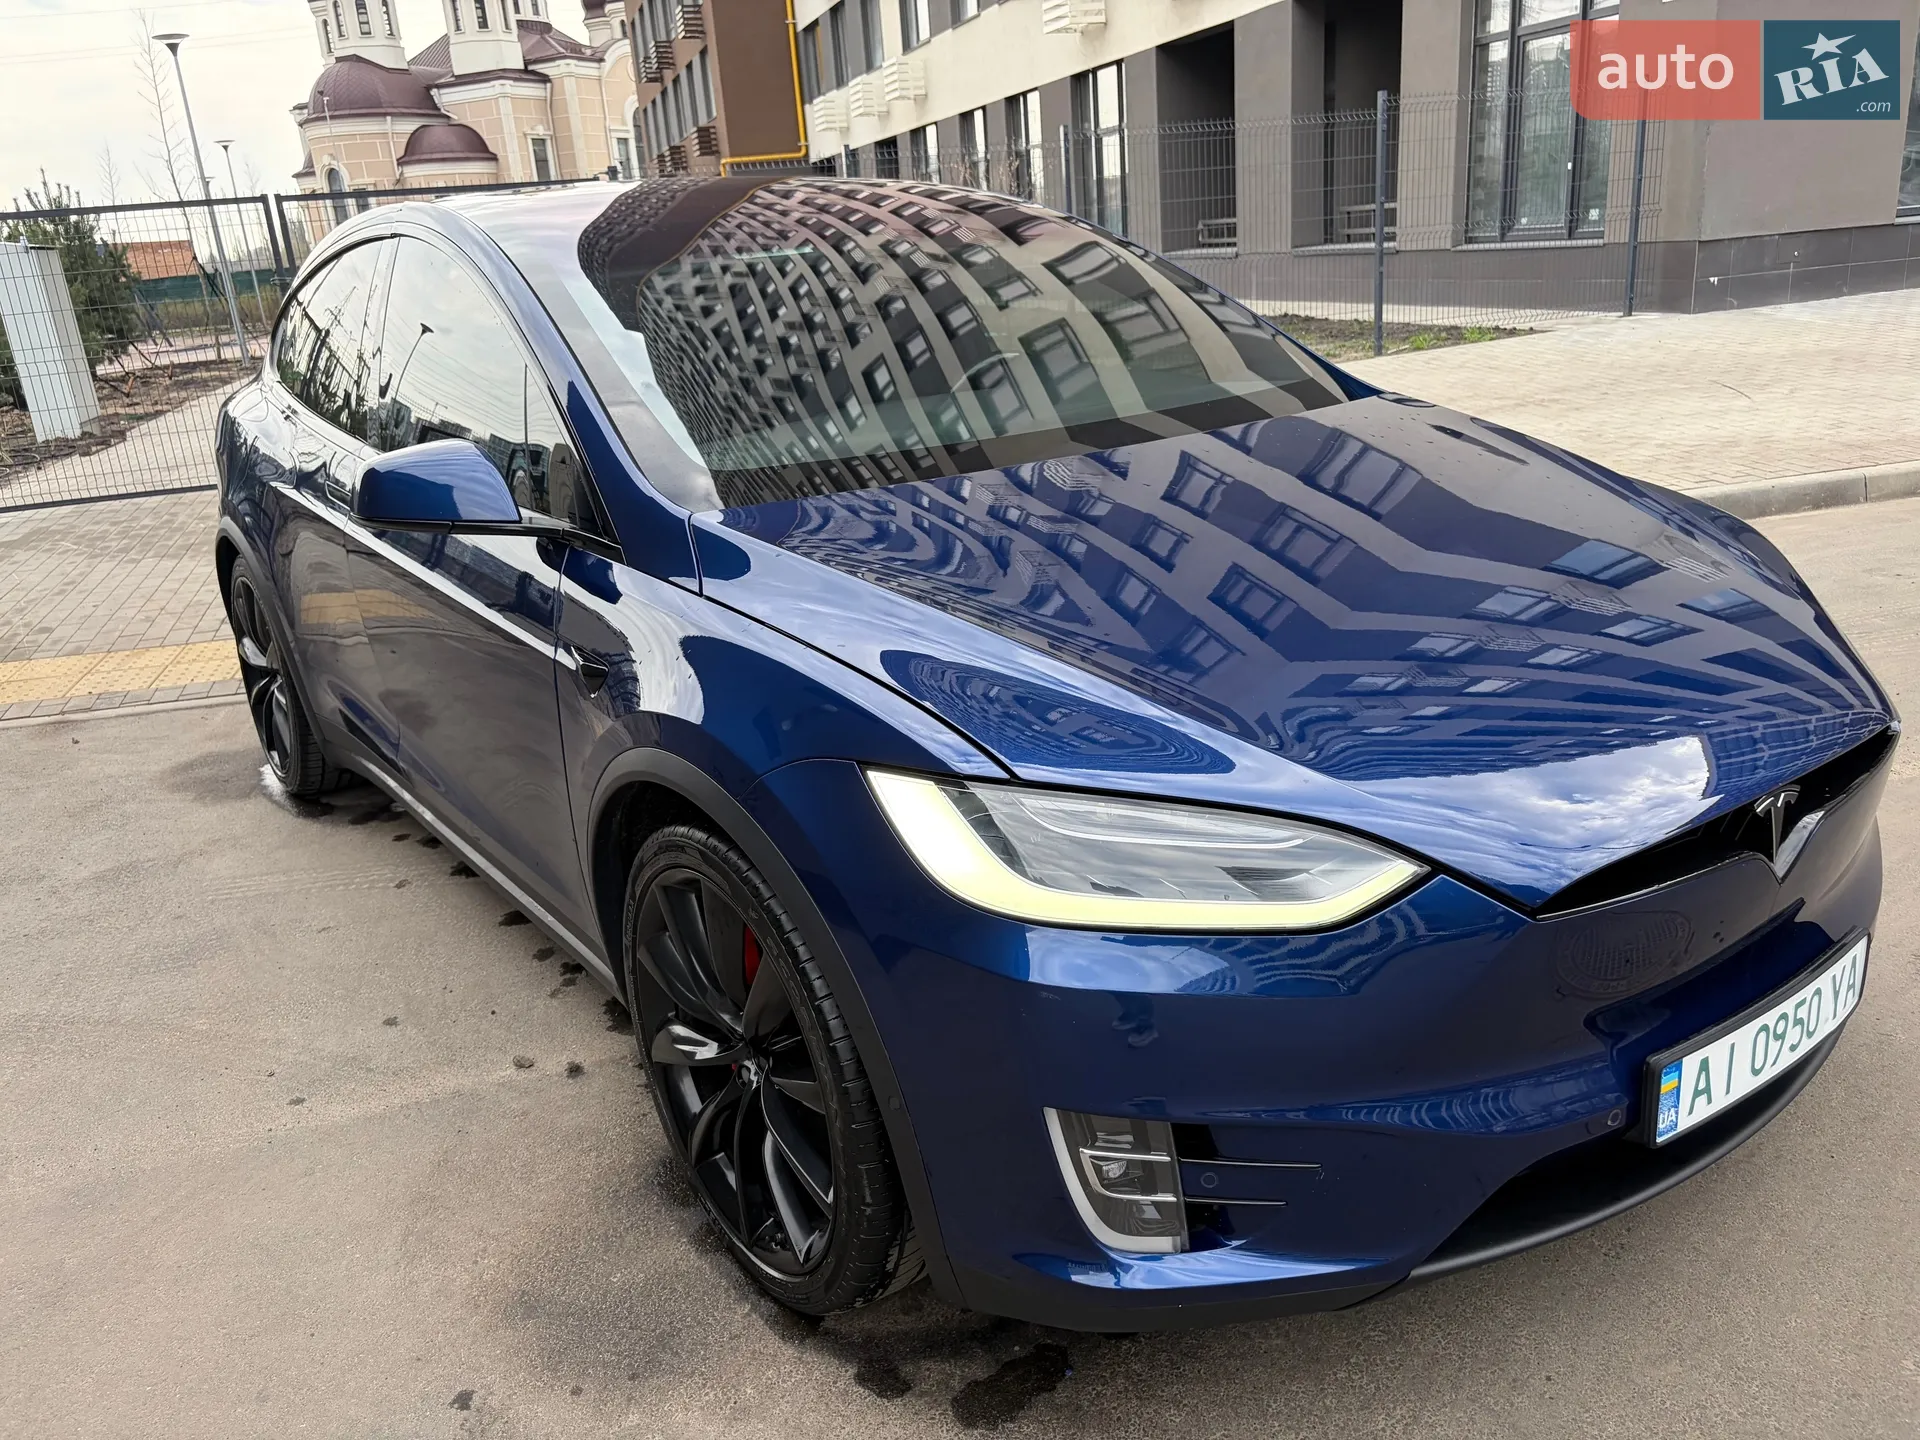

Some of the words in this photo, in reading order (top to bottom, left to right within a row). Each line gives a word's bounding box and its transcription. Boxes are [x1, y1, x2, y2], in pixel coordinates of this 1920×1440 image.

[1750, 986, 1822, 1077] 0950
[1830, 953, 1858, 1021] YA
[1659, 1107, 1676, 1129] UA
